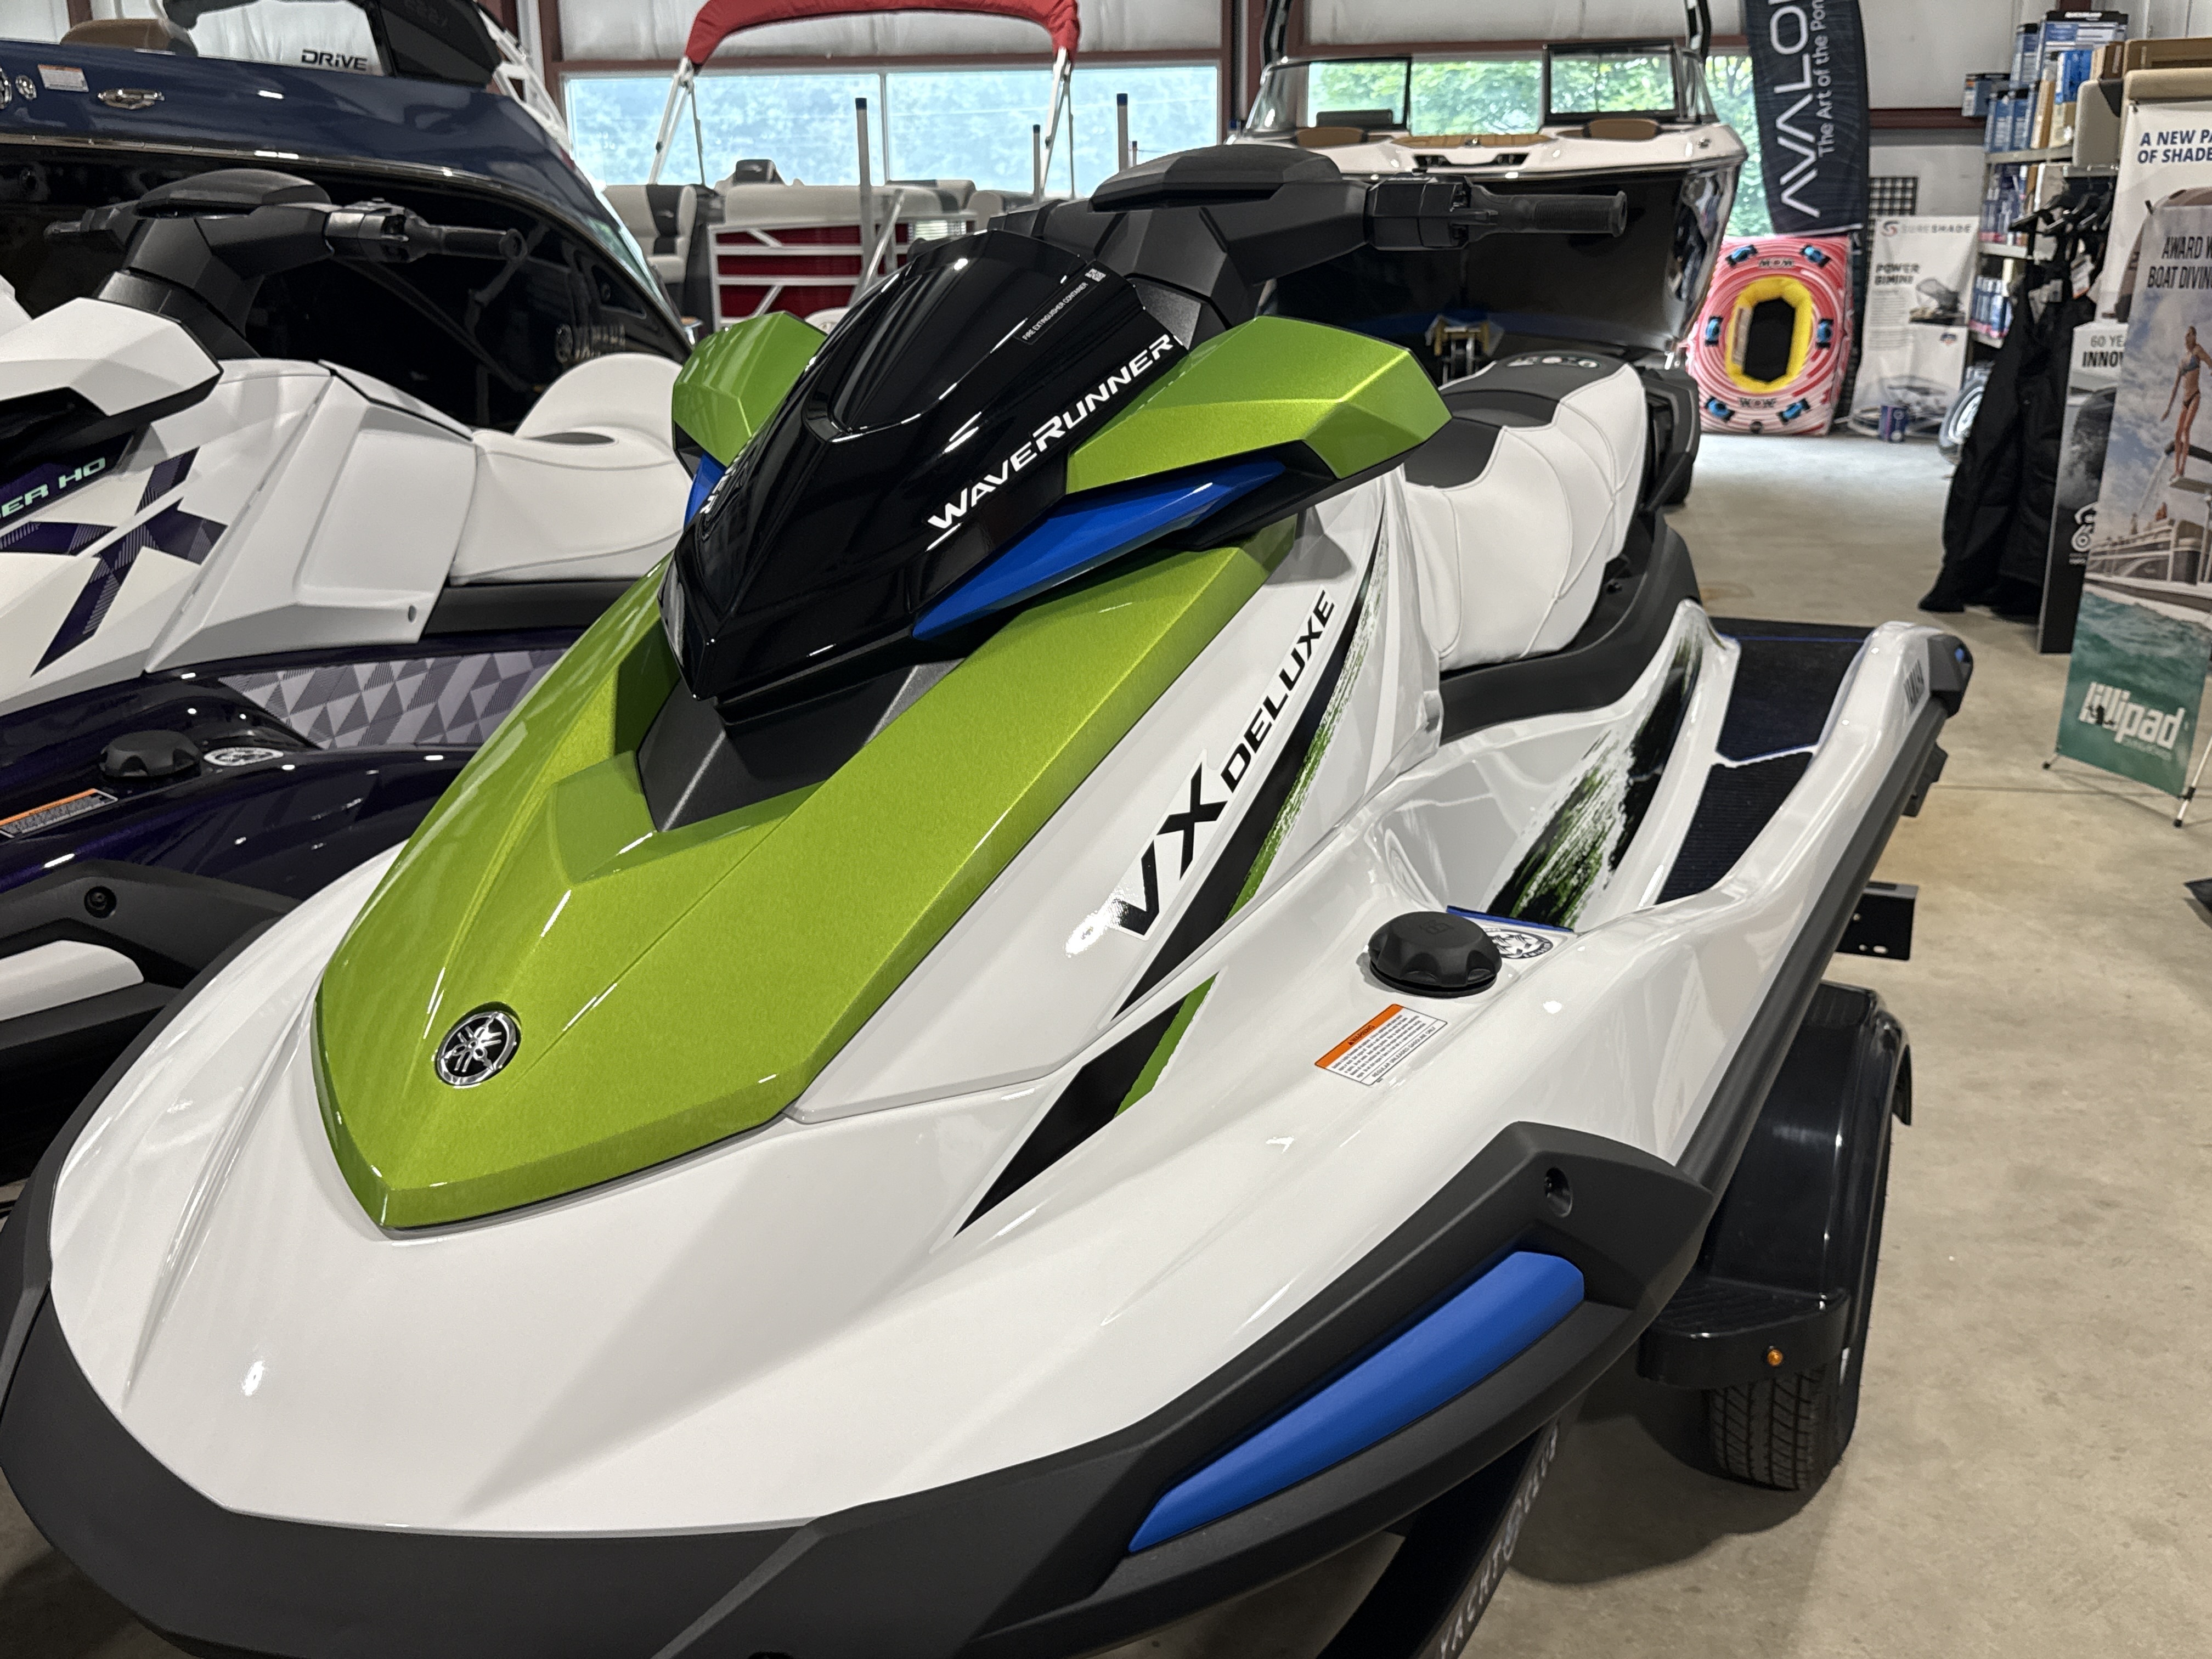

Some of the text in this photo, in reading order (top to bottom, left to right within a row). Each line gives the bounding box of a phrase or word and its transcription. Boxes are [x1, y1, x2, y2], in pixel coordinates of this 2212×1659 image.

[1812, 35, 1830, 65] the
[1813, 69, 1831, 87] of
[1768, 0, 1821, 218] AVALO
[1816, 89, 1833, 119] Art
[1818, 123, 1835, 157] The
[2140, 132, 2151, 146] A
[2157, 130, 2196, 145] NEW
[2137, 149, 2158, 163] OF
[2162, 236, 2203, 259] AWARD
[1876, 263, 1920, 274] POWER
[2147, 266, 2178, 289] BOAT
[2109, 335, 2126, 347] YE
[0, 457, 106, 518] ER HO
[1109, 590, 1334, 936] VX DELUXE
